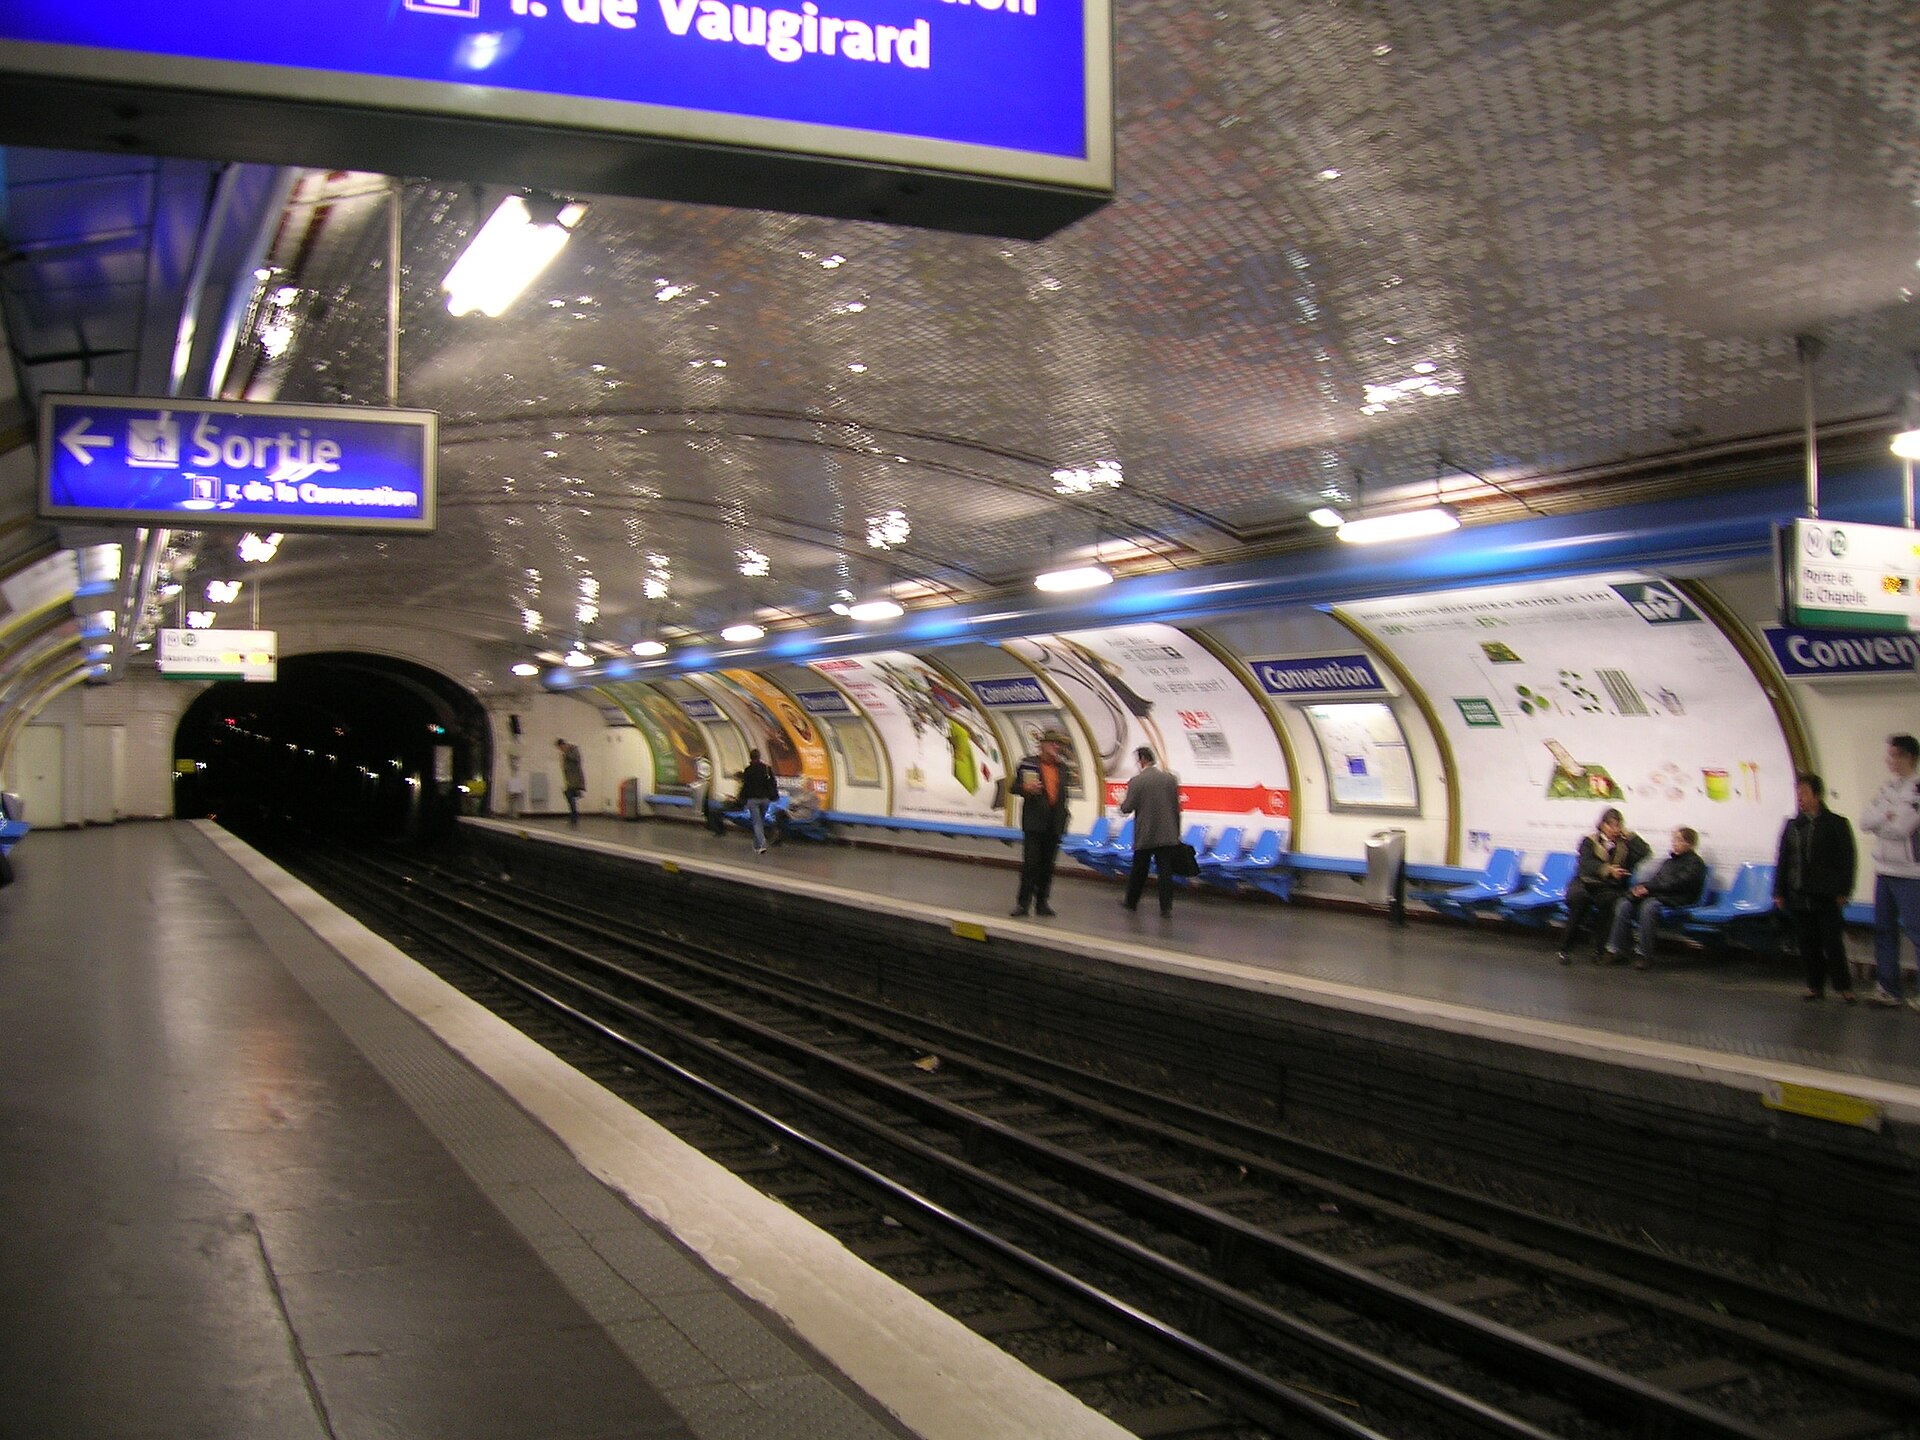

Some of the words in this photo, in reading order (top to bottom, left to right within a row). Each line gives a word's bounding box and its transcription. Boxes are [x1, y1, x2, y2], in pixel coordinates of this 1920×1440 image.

[658, 0, 931, 70] Vaugirard
[190, 420, 342, 472] Sortie
[242, 480, 274, 502] de
[298, 483, 418, 507] Convention
[1262, 661, 1376, 690] Convention
